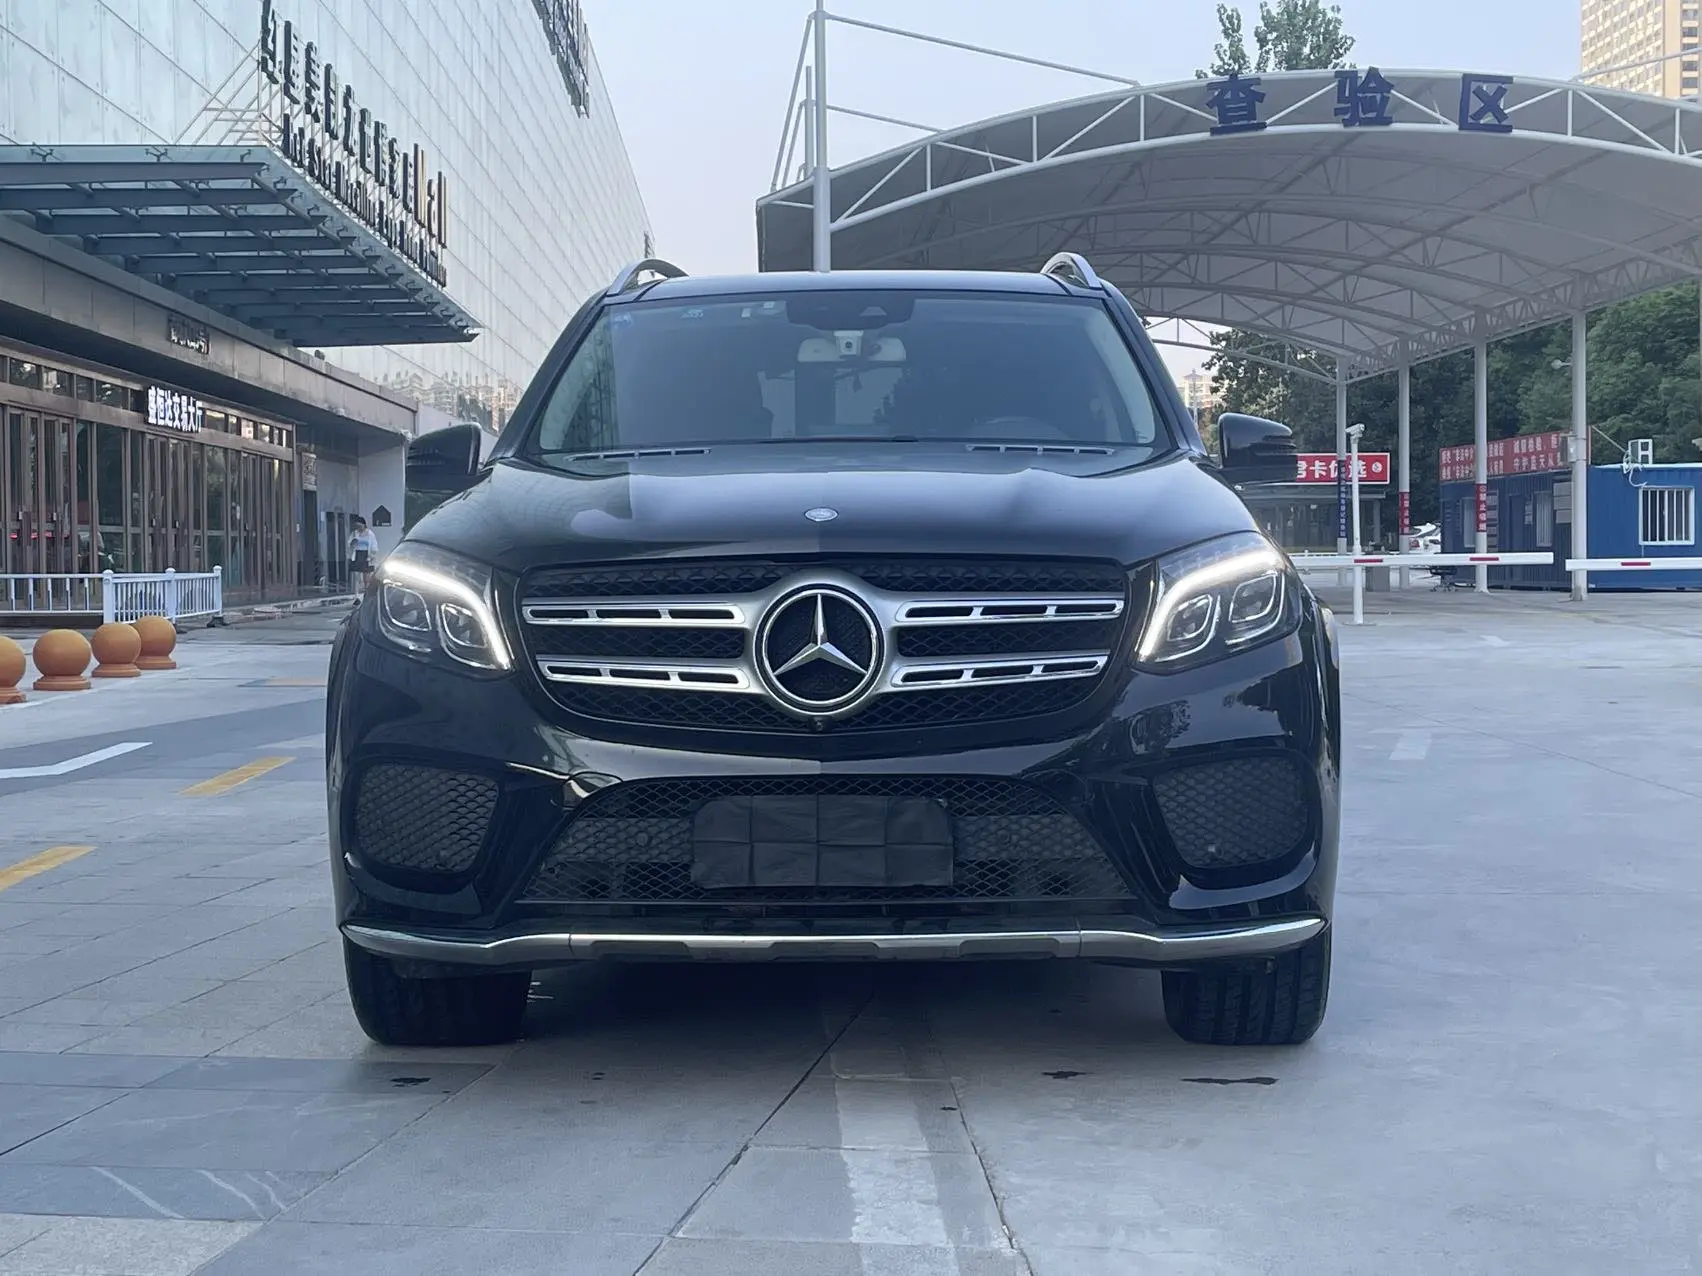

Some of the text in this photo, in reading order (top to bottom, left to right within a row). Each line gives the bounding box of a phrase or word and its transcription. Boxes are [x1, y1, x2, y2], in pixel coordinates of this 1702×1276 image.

[1206, 66, 1513, 135] 查验区
[148, 385, 203, 433] 盛恒达交易大厅
